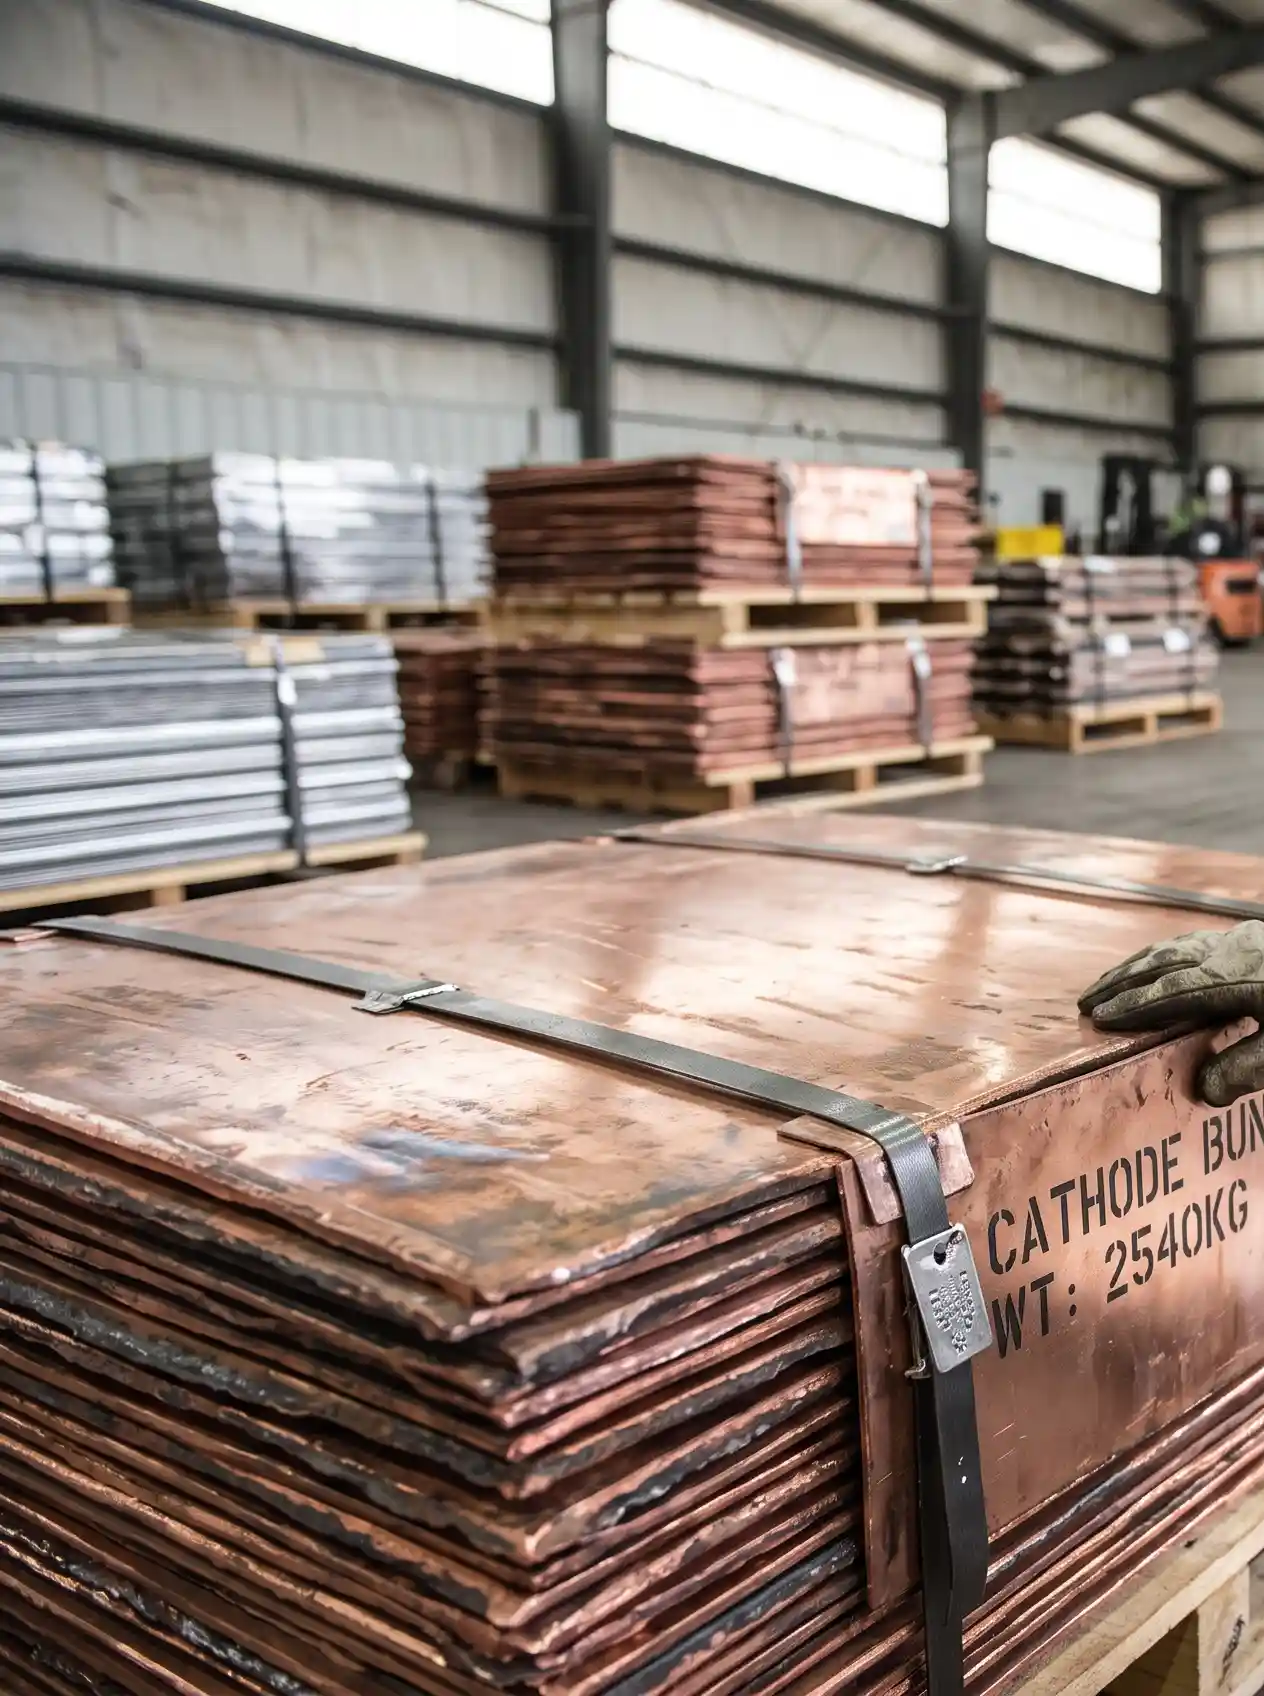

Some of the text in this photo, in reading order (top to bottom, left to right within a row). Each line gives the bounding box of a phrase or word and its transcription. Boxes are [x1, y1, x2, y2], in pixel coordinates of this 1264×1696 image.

[988, 1133, 1184, 1275] CATHODE
[992, 1273, 1077, 1358] WT:
[1105, 1178, 1248, 1303] 2540KG
